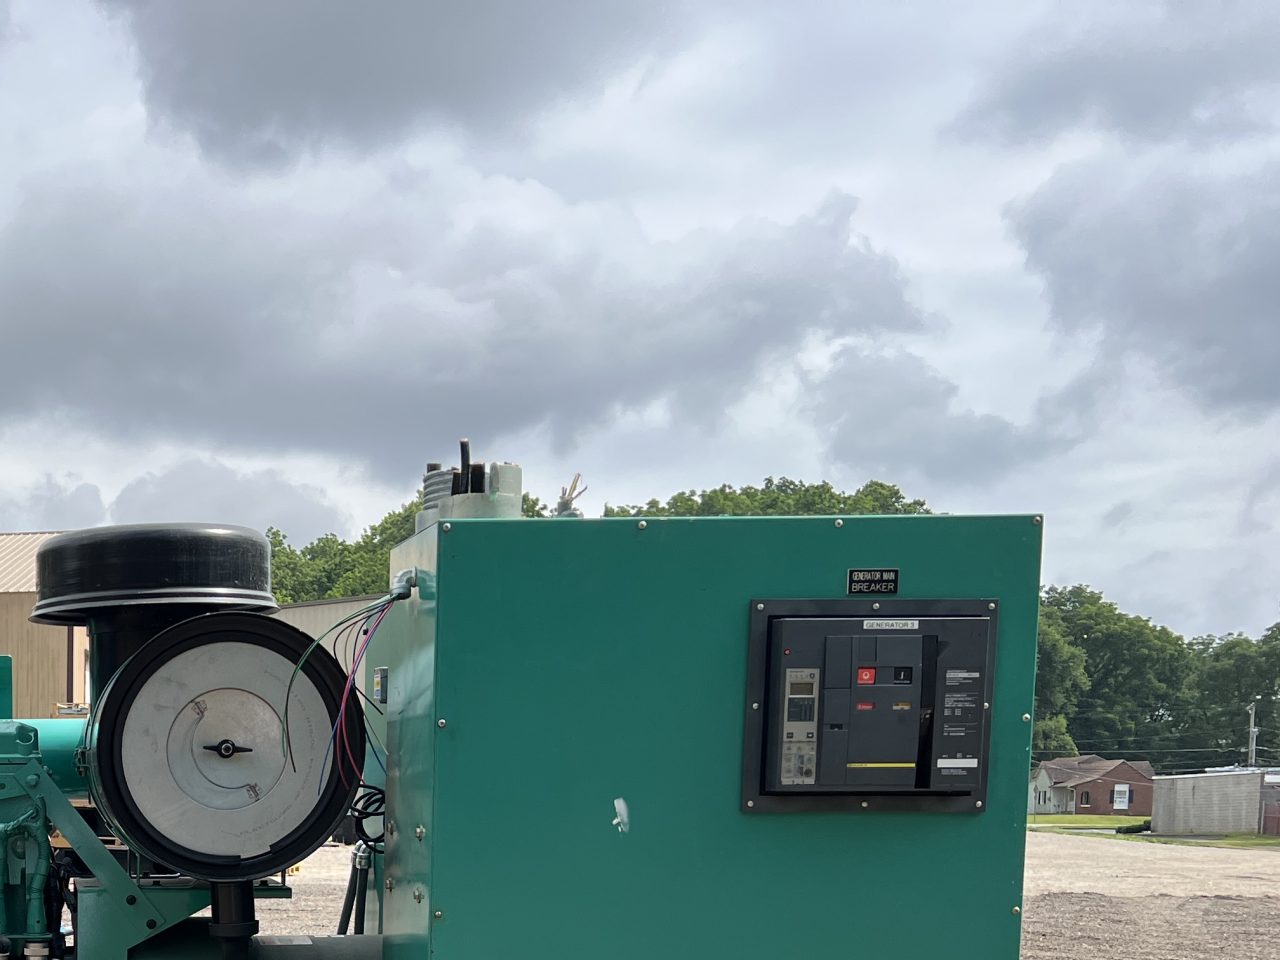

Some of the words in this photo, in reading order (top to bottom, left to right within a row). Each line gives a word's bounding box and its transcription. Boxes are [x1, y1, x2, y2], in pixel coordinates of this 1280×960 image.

[852, 571, 881, 581] GENERATOR
[882, 571, 896, 580] MAIN
[851, 582, 895, 592] BREAKER
